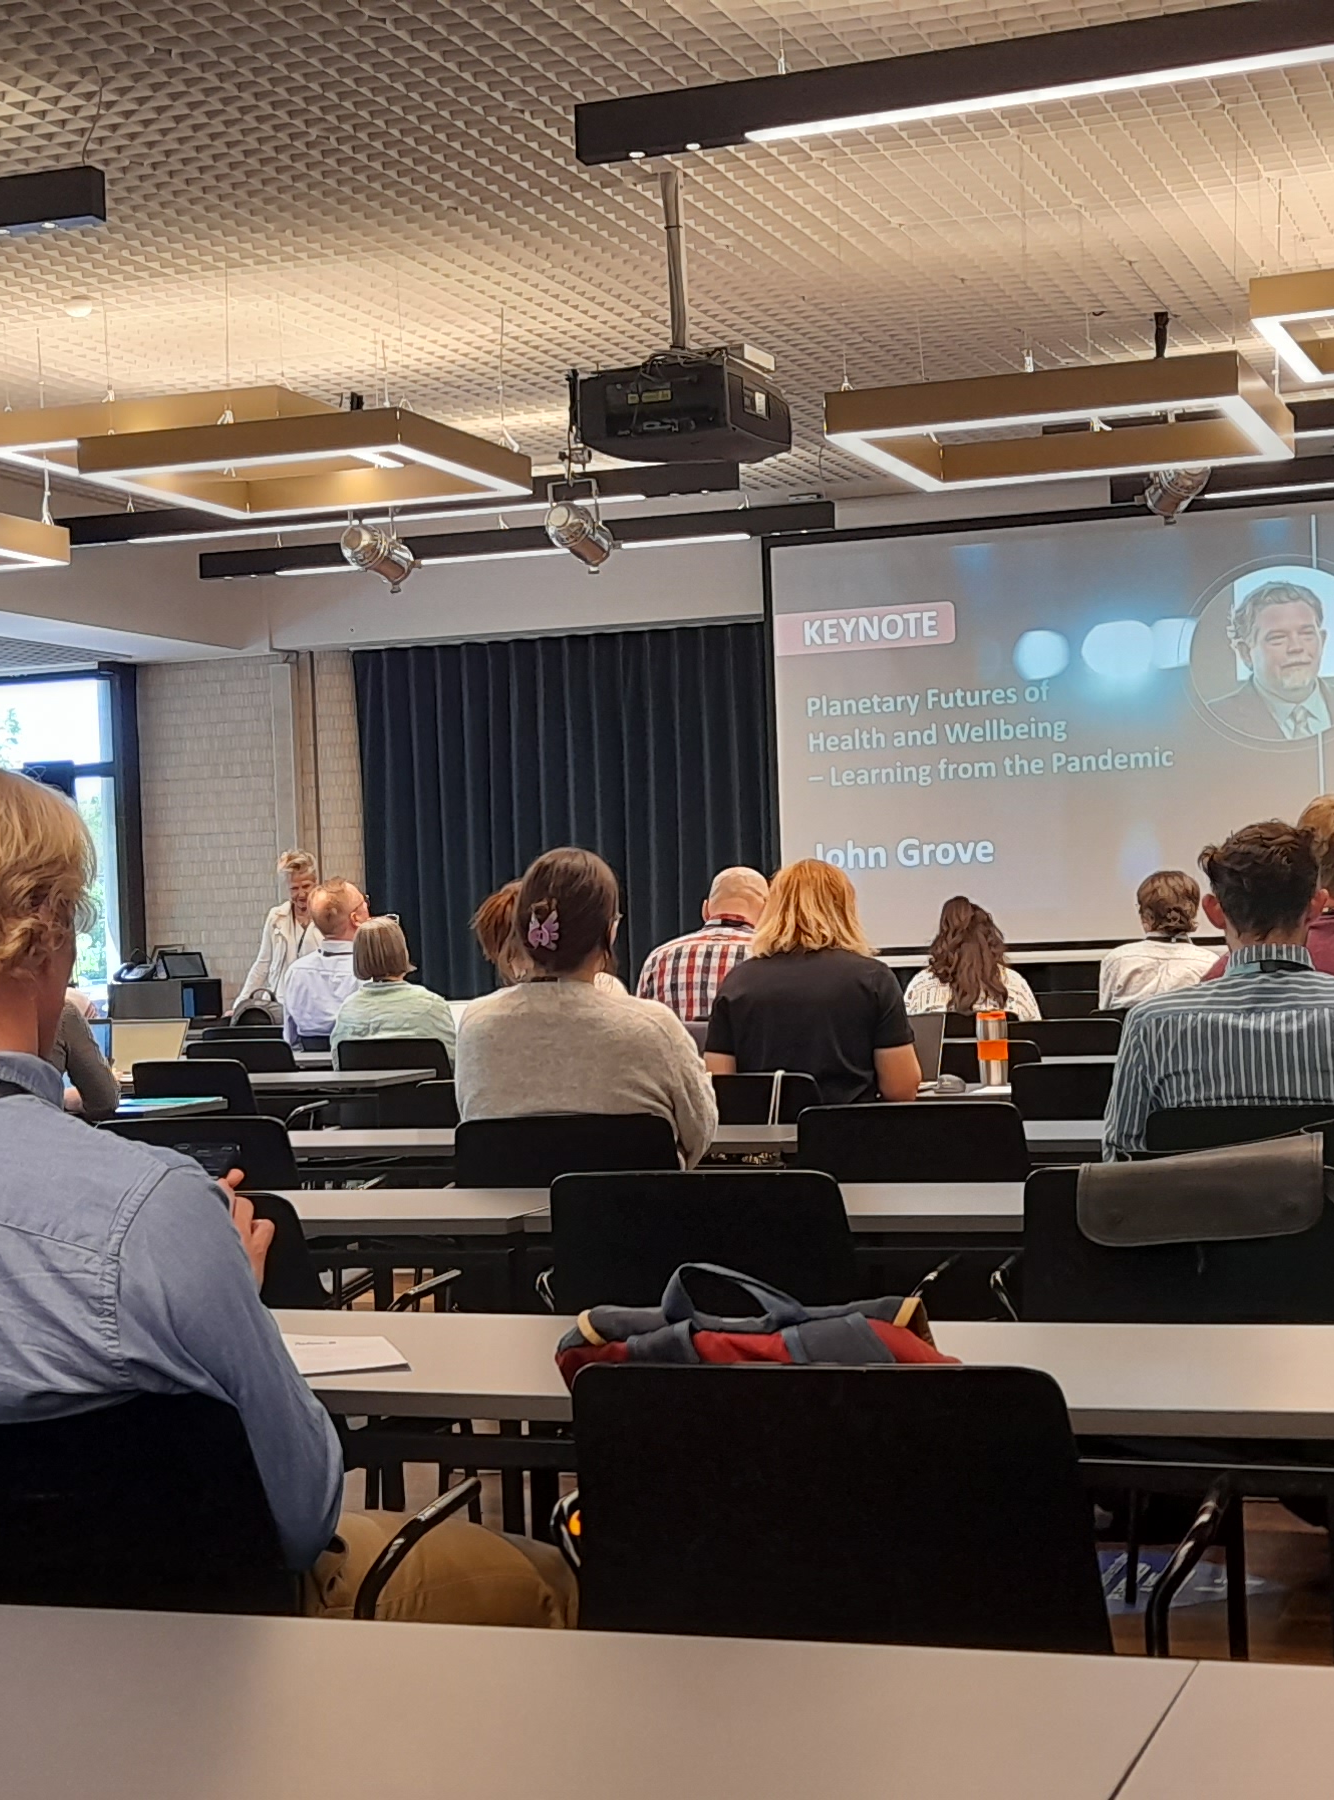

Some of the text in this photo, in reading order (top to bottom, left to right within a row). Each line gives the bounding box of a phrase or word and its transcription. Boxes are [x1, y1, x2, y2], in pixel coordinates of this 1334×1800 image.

[803, 610, 939, 646] KEYNOTE
[806, 680, 1050, 718] Planetary Futures of
[808, 717, 1068, 752] Health and Wellbeing
[830, 761, 932, 786] Learning
[938, 758, 997, 780] from
[1003, 754, 1044, 776] the
[1052, 746, 1175, 774] Pandemic
[815, 837, 994, 869] John Grove
